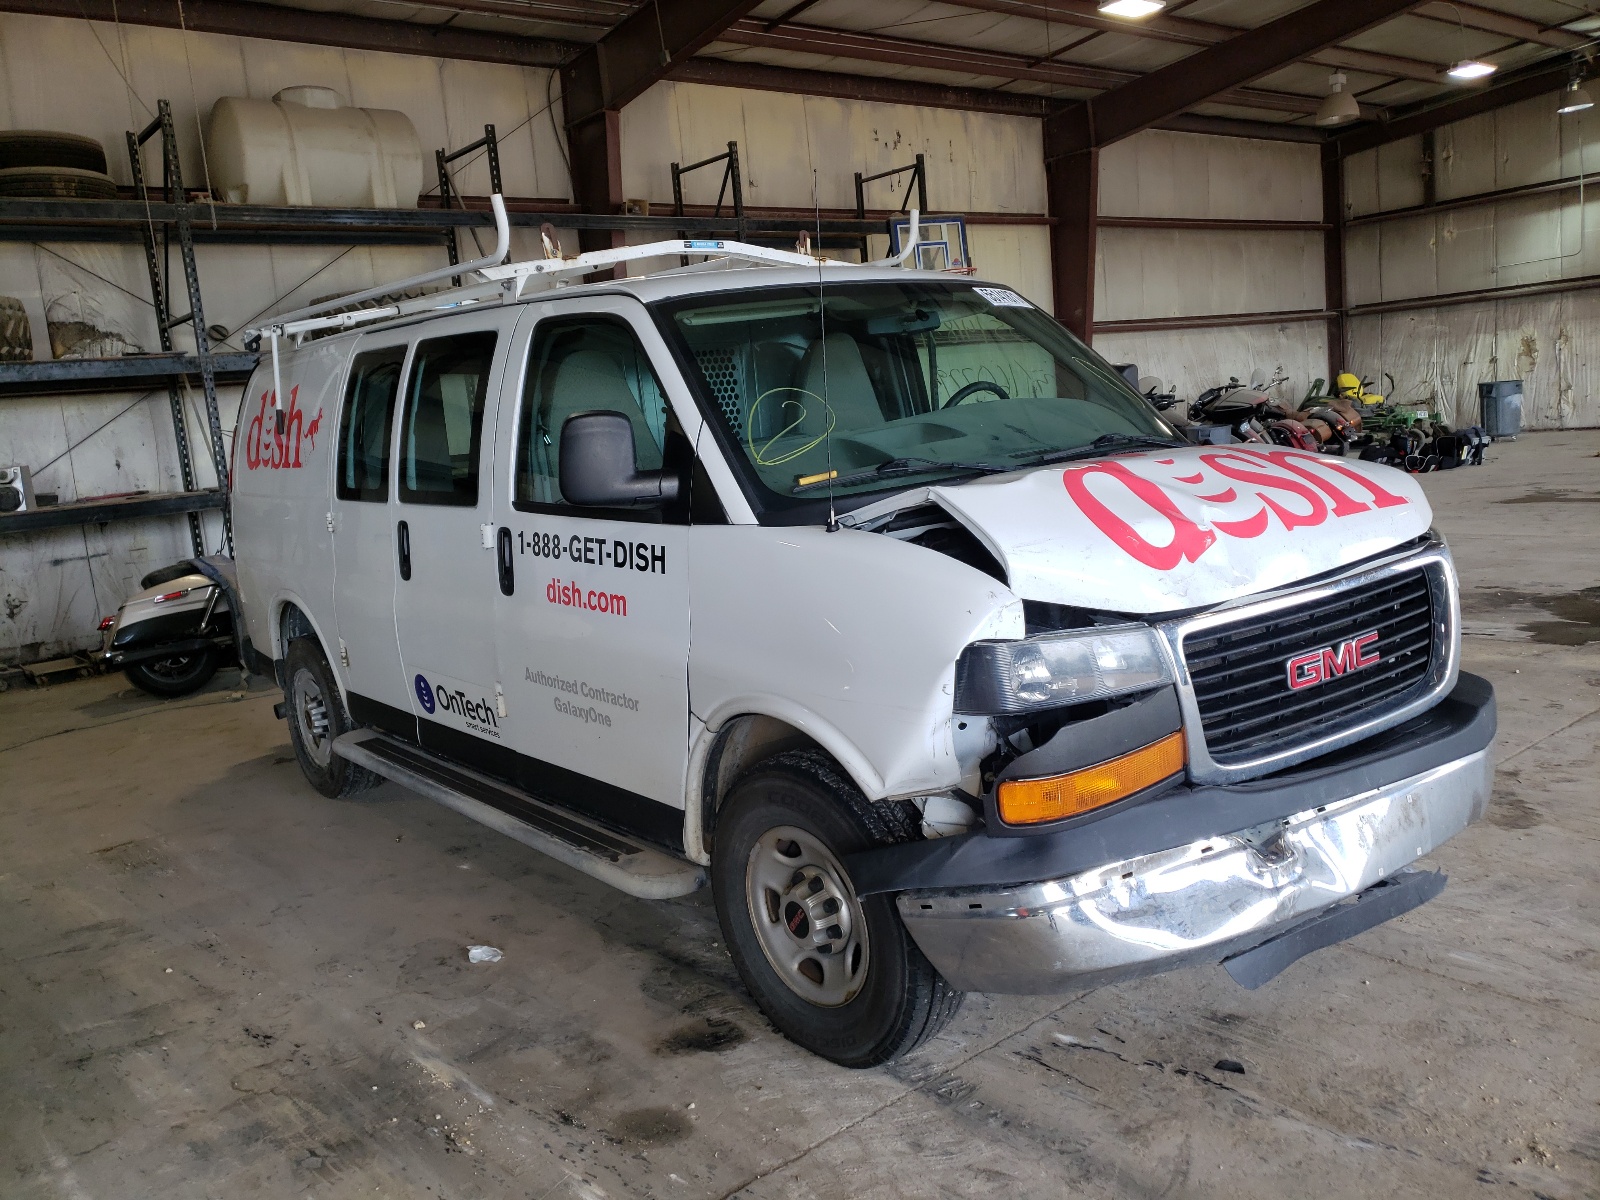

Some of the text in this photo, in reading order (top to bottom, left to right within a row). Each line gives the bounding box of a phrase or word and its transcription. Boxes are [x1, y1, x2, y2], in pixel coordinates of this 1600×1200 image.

[755, 399, 829, 465] 2
[517, 530, 667, 575] 1-888-GET-DISH
[546, 577, 628, 617] dish.com
[1287, 630, 1380, 691] GMC
[435, 684, 499, 729] OnTech
[524, 666, 639, 712] Authorized Contractor
[553, 696, 612, 728] GalaxyOne
